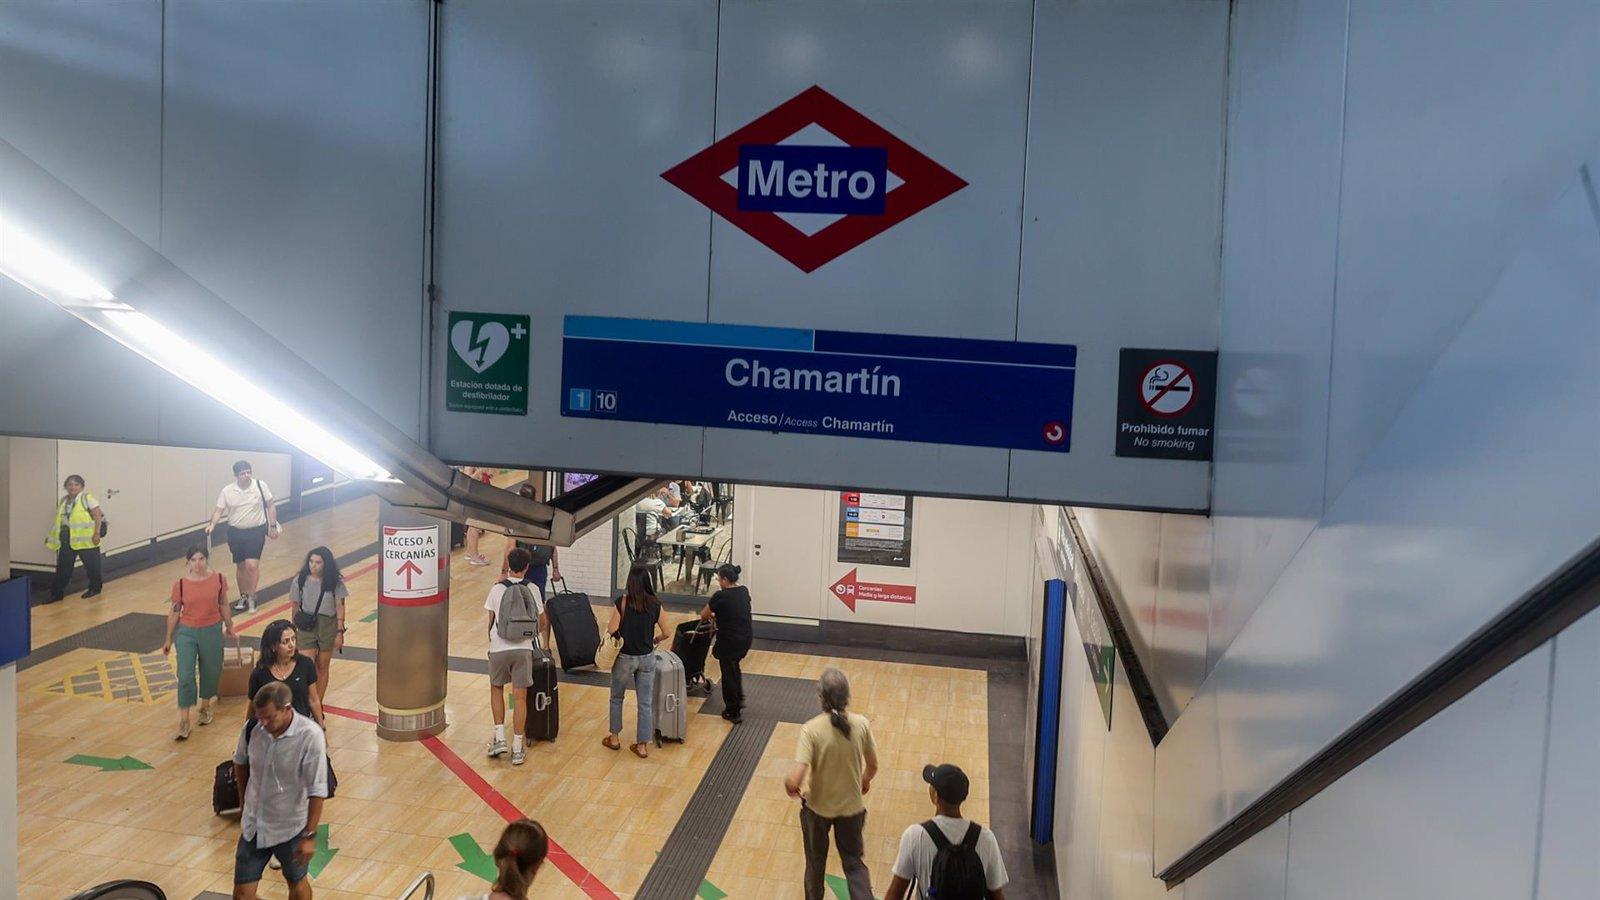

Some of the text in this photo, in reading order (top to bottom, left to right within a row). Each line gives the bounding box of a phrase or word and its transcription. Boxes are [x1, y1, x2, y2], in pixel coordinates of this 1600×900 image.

[747, 159, 876, 200] Metro
[725, 358, 901, 397] Chamartín
[450, 380, 523, 392] Estación dotada de
[462, 390, 510, 401] desfibrilador
[597, 392, 616, 411] 10
[822, 416, 894, 433] Chamartín
[1121, 423, 1210, 437] Prohibido fumar
[1133, 436, 1196, 451] No smoking
[387, 536, 433, 547] ACCESO A
[385, 548, 436, 560] CERCANÍAS
